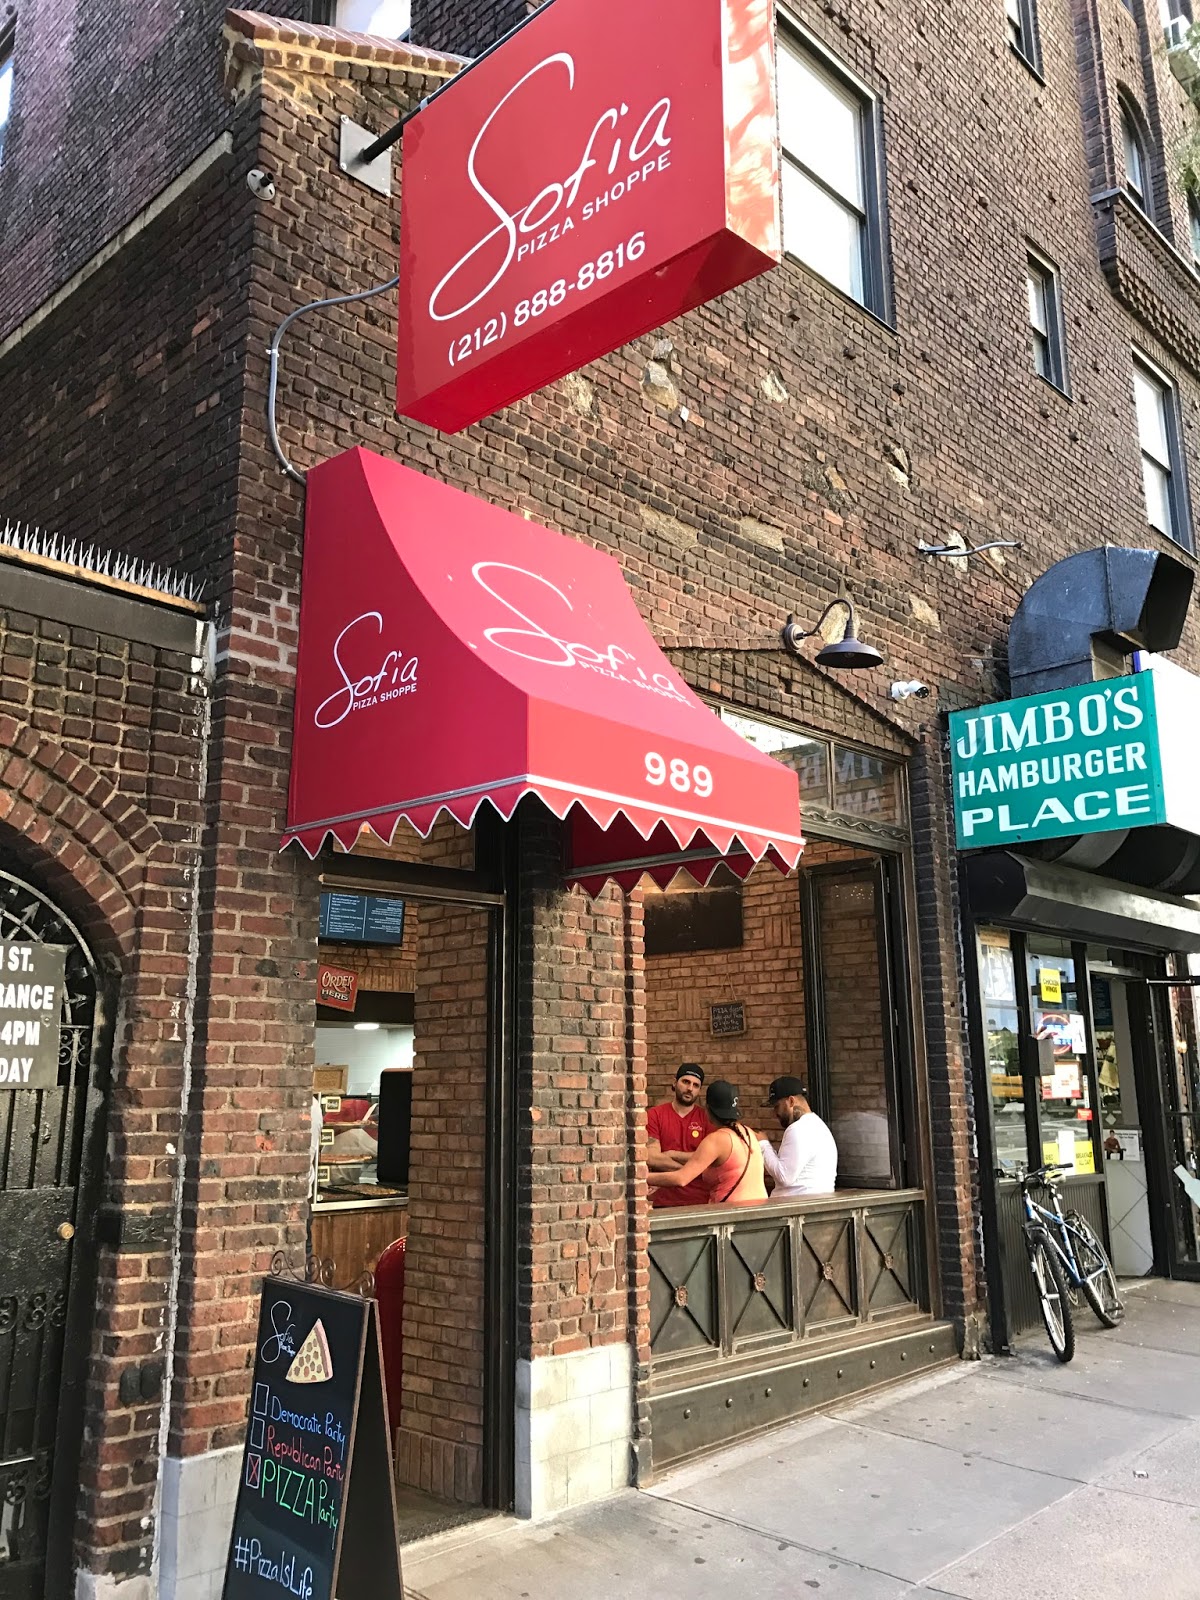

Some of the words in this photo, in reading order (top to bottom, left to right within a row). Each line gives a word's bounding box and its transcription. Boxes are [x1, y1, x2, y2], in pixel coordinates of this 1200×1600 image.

[429, 51, 672, 322] Sofia
[516, 219, 575, 263] PIZZA
[581, 149, 673, 222] SHOPPE
[448, 311, 508, 367] (212)
[513, 231, 647, 328] 888-8816
[472, 561, 686, 699] Sofia
[314, 611, 419, 729] Sofia
[352, 695, 379, 711] PIZZA
[379, 682, 418, 703] SHOPPE
[577, 660, 632, 684] PIZZA
[956, 685, 1144, 759] JIMBO'S
[644, 751, 715, 798] 989
[958, 741, 1147, 798] HAMBURGER
[961, 783, 1151, 837] PLACE
[7, 945, 35, 972] ST.
[321, 970, 355, 993] ORDER
[321, 988, 349, 1001] HERE
[1045, 985, 1058, 994] WINGS
[0, 1020, 41, 1046] 4PM
[0, 1057, 34, 1083] DAY
[266, 1424, 321, 1472] Republican
[323, 1445, 344, 1482] Party
[270, 1395, 322, 1435] Democratic
[324, 1411, 346, 1461] Party
[261, 1458, 314, 1524] PIZZA
[317, 1478, 339, 1550] Party
